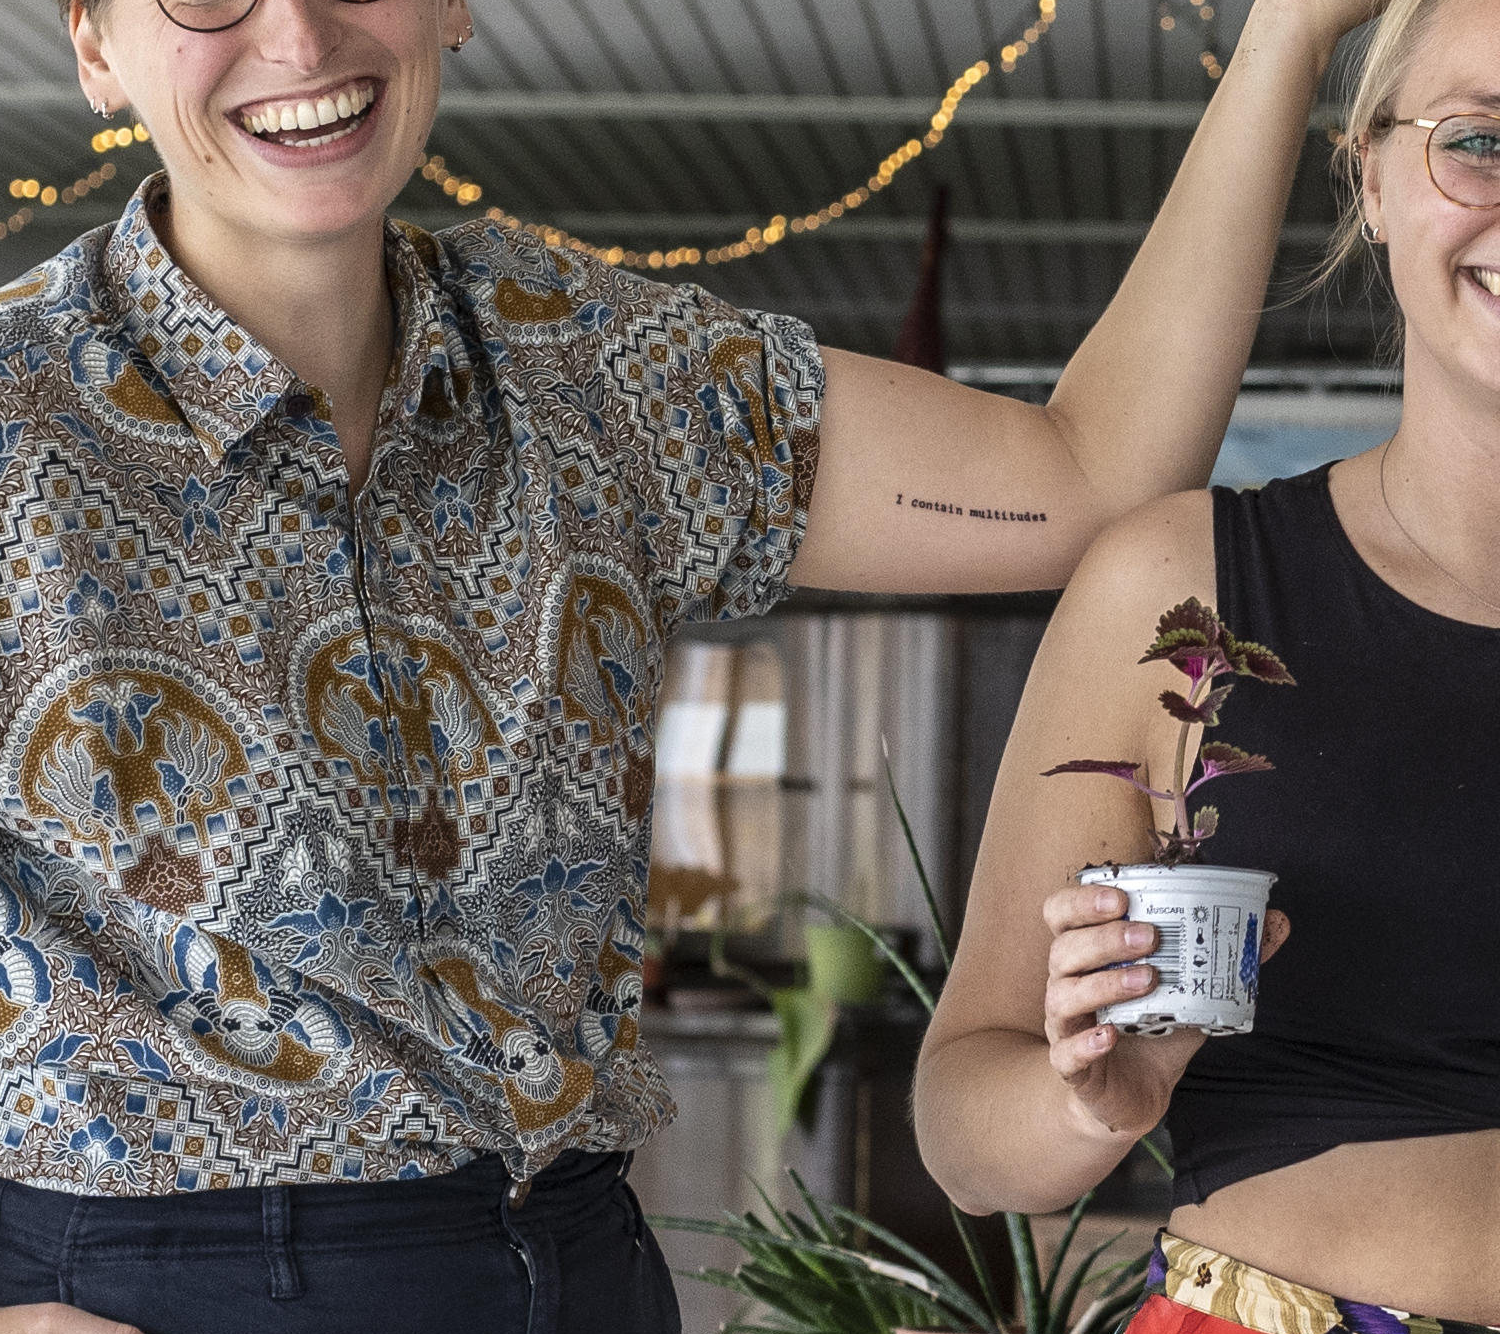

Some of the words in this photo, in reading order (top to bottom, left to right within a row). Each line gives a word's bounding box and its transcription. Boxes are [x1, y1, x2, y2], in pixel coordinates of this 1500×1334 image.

[896, 493, 903, 505] I
[911, 498, 964, 516] contain
[969, 508, 1048, 523] multitudes
[1146, 906, 1185, 915] MUSCARI
